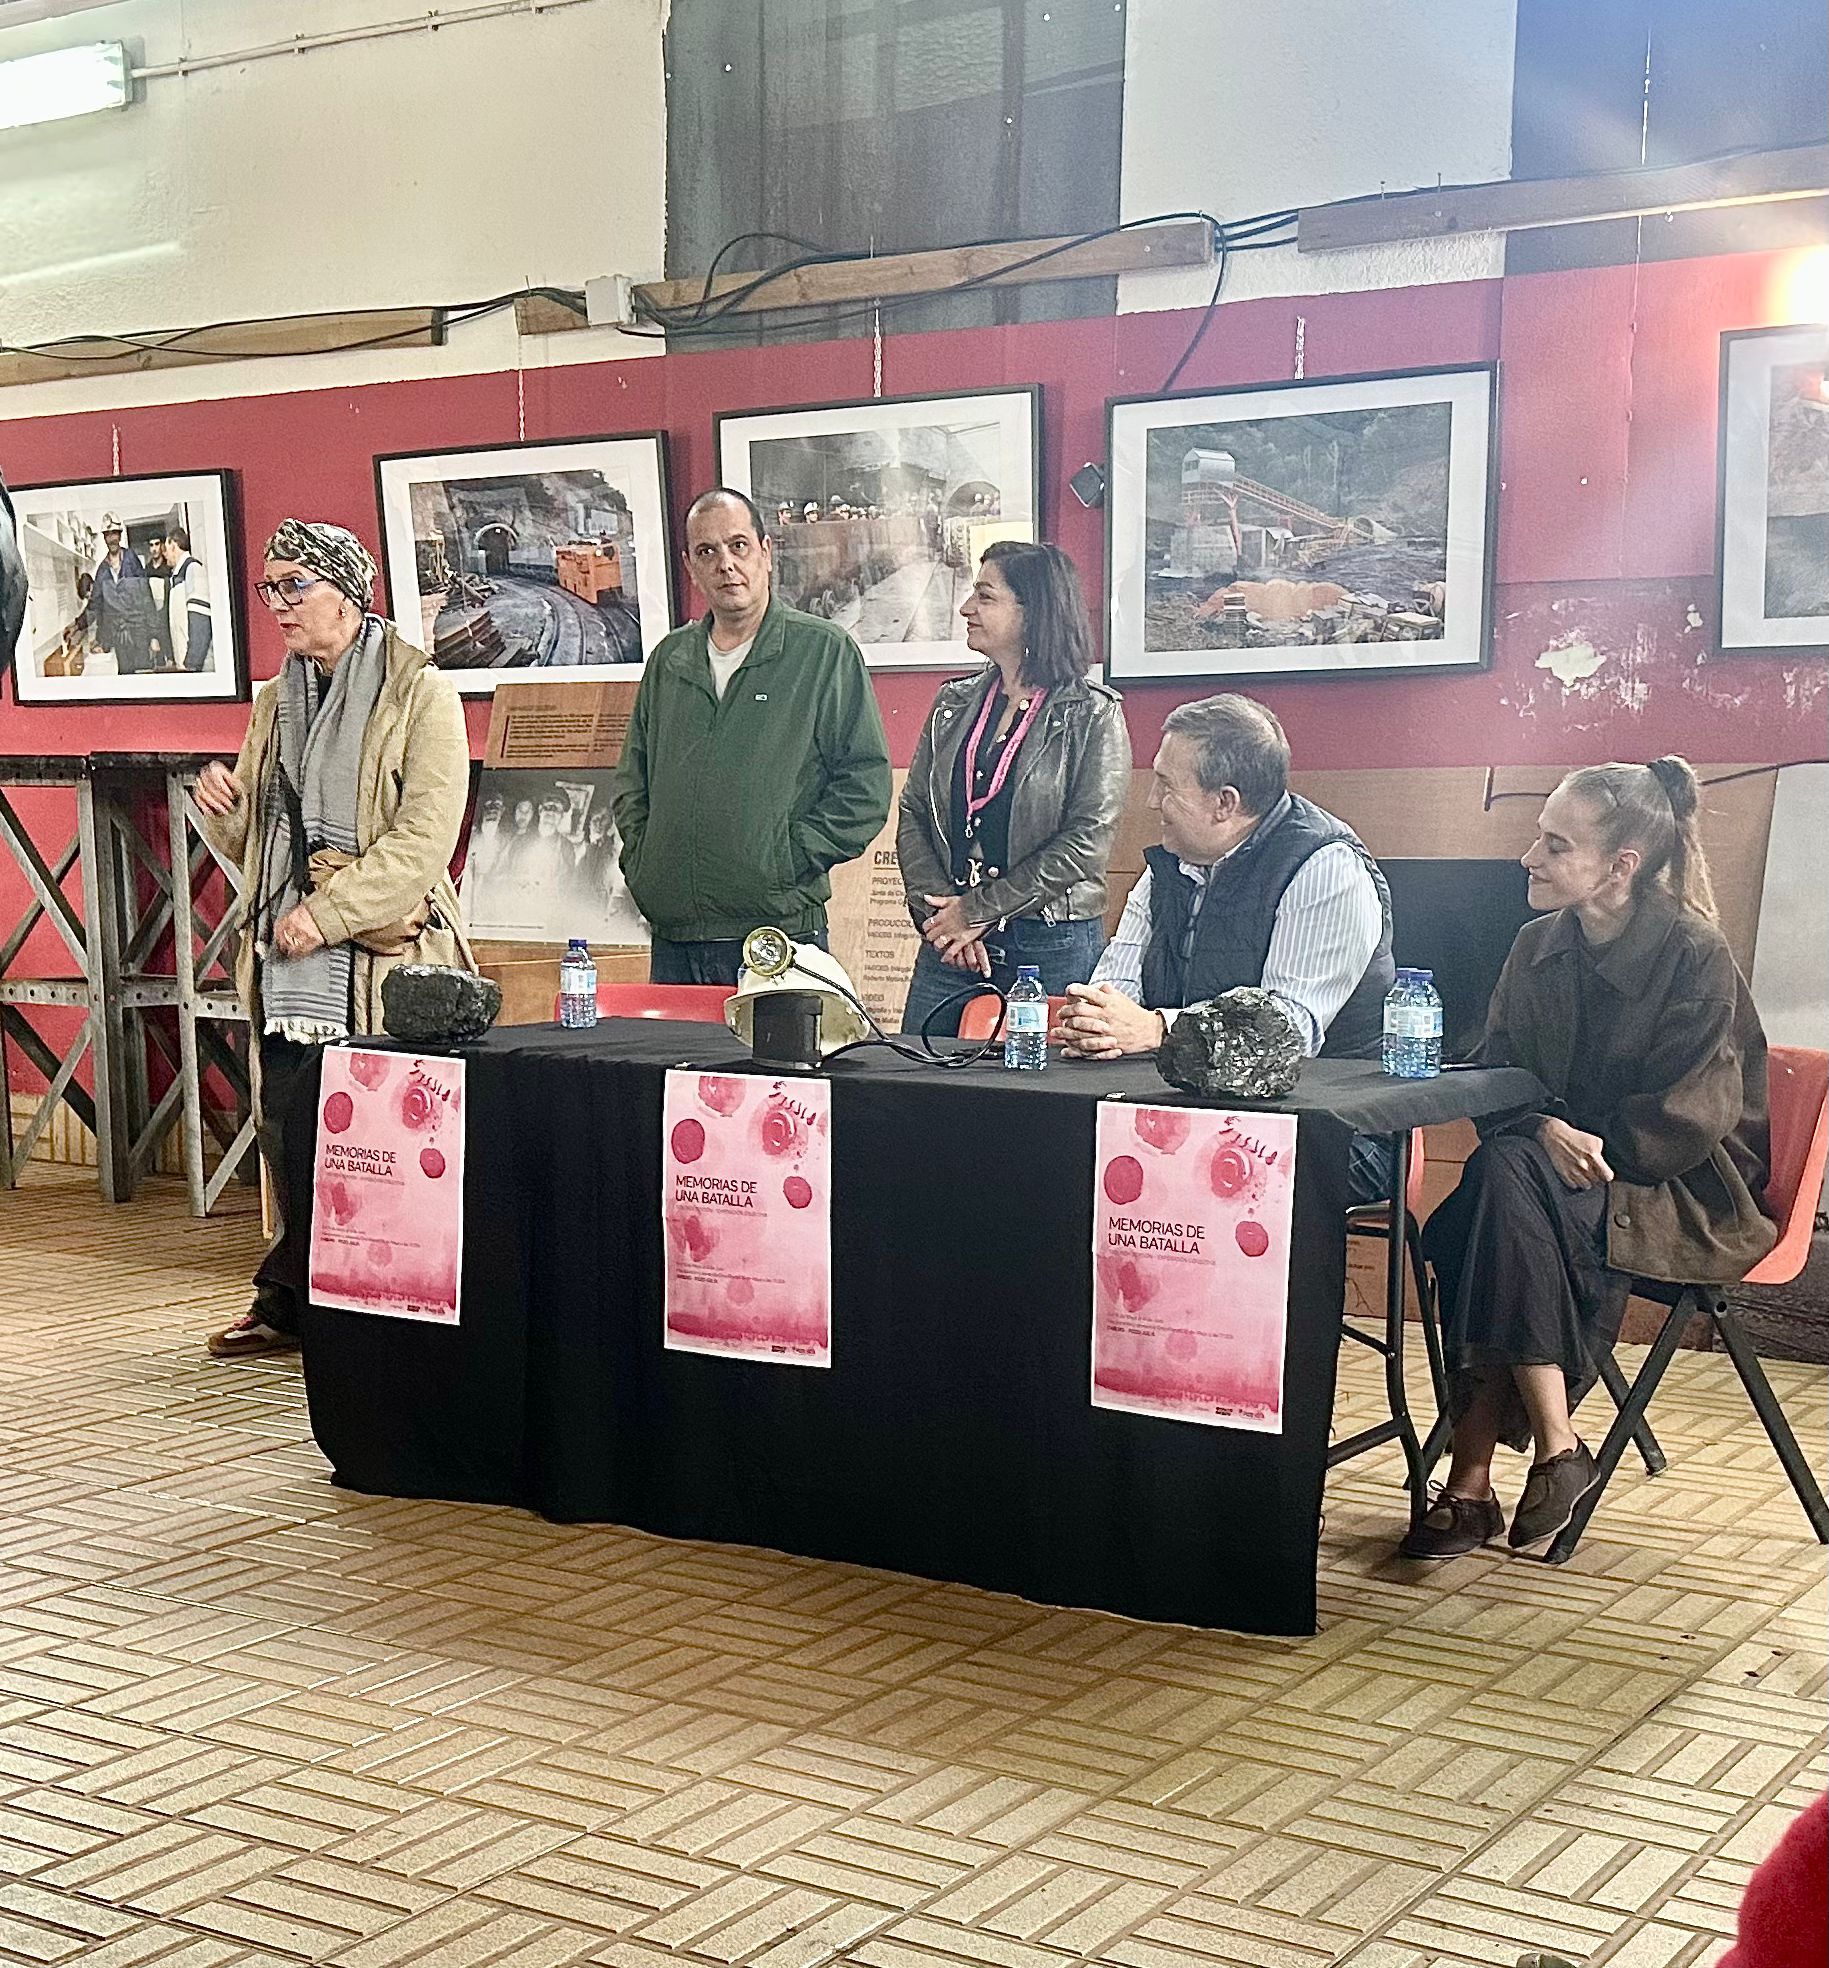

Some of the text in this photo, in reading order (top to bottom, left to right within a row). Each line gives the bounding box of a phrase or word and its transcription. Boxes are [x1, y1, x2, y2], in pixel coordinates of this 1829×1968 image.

[865, 950, 895, 959] TEXTOS
[325, 1144, 397, 1164] MEMORIAS DE
[325, 1157, 393, 1176] UNA BATALLA
[675, 1175, 757, 1194] MEMORIAS DE
[675, 1189, 754, 1208] UNA BATALLA
[1108, 1216, 1205, 1240] MEMORIAS DE
[1108, 1233, 1137, 1248] UNA
[1139, 1236, 1200, 1255] BATALLA
